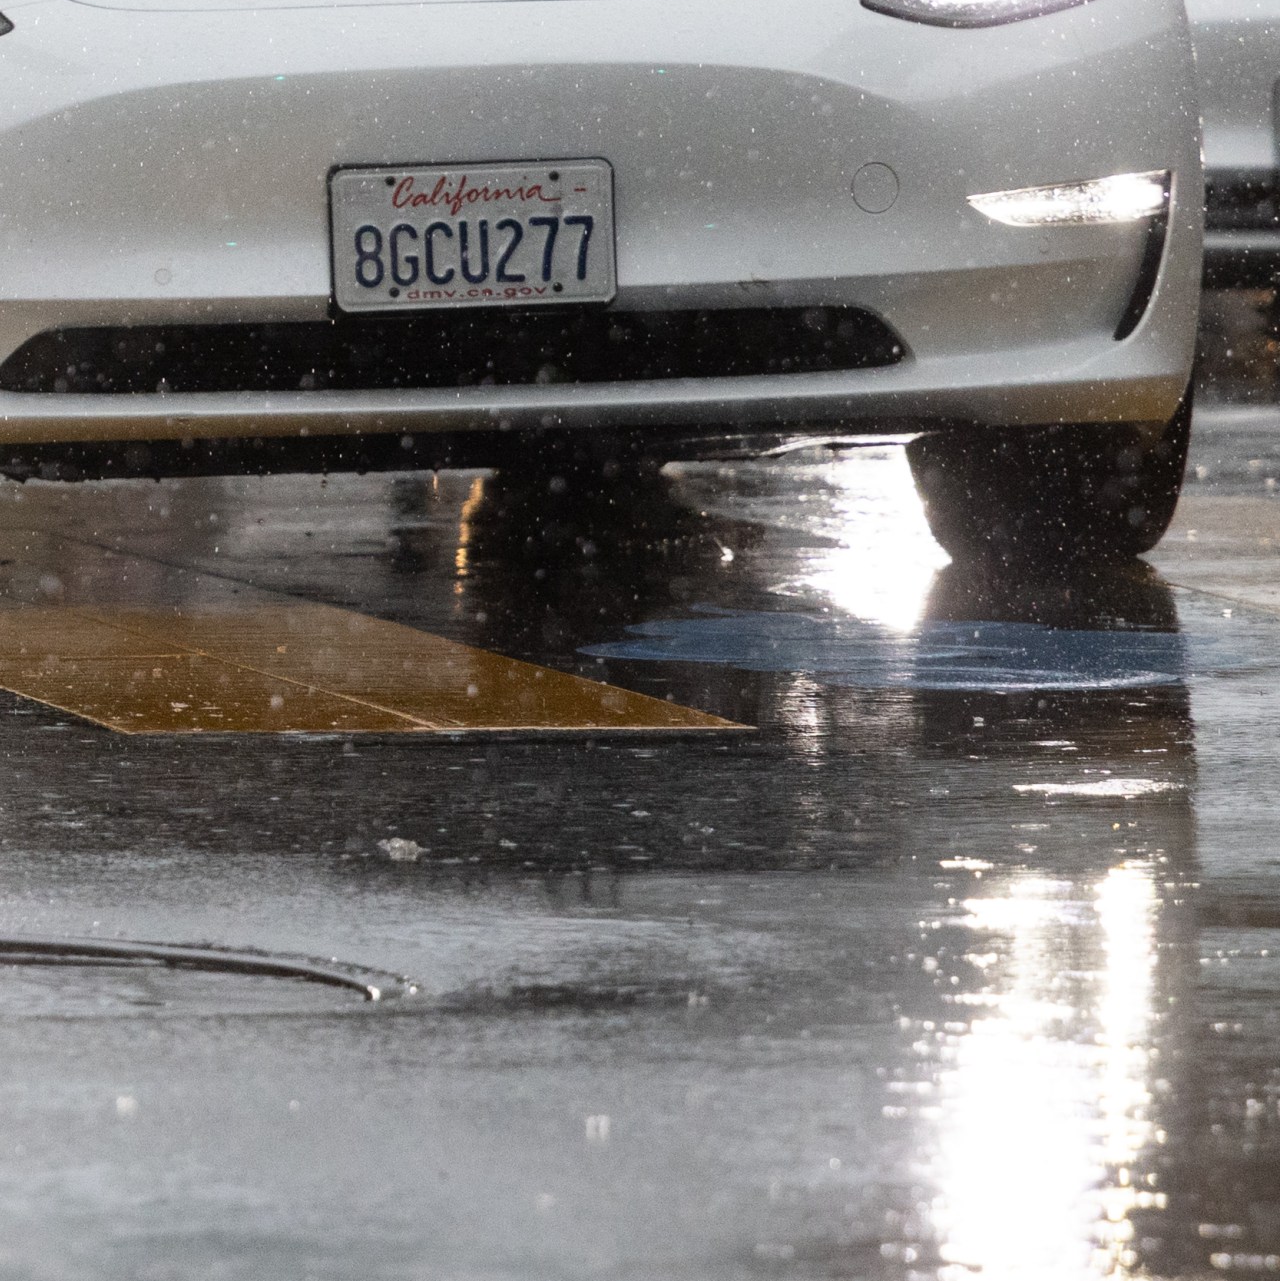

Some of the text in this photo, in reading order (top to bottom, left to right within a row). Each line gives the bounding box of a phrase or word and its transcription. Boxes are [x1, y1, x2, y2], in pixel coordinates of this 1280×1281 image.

[391, 175, 561, 216] California
[354, 215, 594, 288] 8GCU277
[407, 285, 548, 300] dmv.ca.gov
